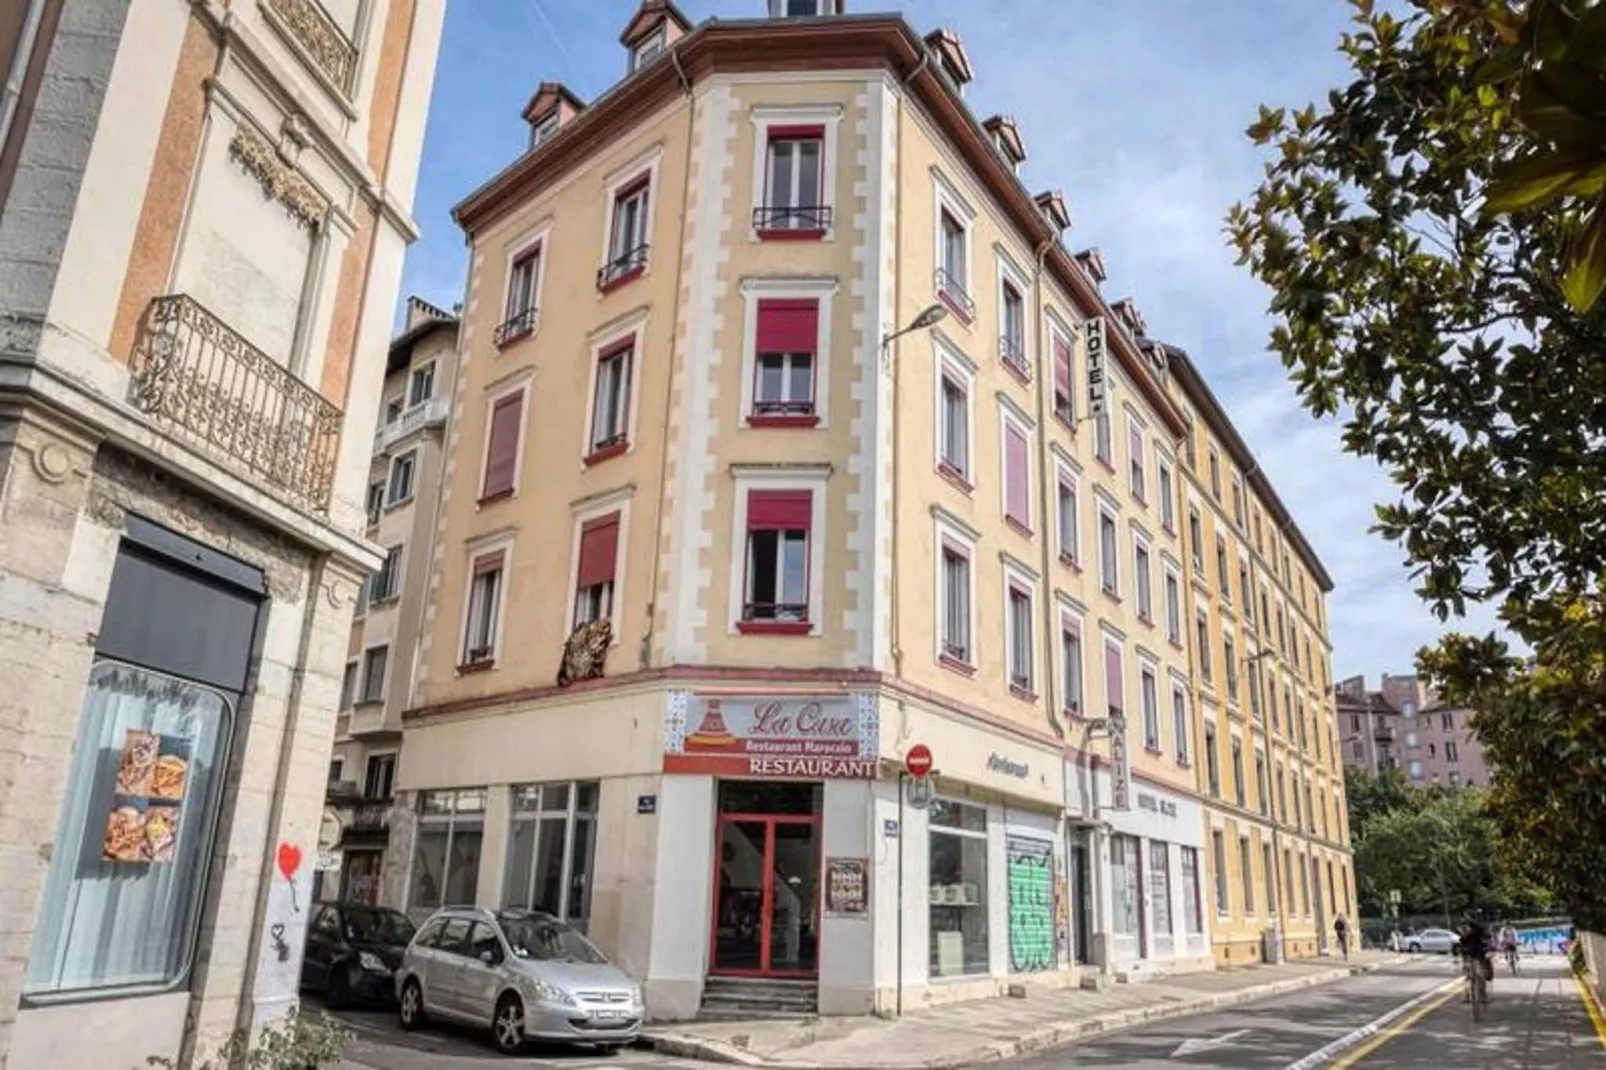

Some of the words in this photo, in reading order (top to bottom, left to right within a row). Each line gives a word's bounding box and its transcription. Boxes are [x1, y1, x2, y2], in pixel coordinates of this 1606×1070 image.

[1087, 320, 1103, 401] HOTEL
[749, 700, 792, 733] La
[745, 739, 802, 753] Restaurant
[805, 741, 852, 754] Marocain
[749, 758, 874, 777] RESTAURANT
